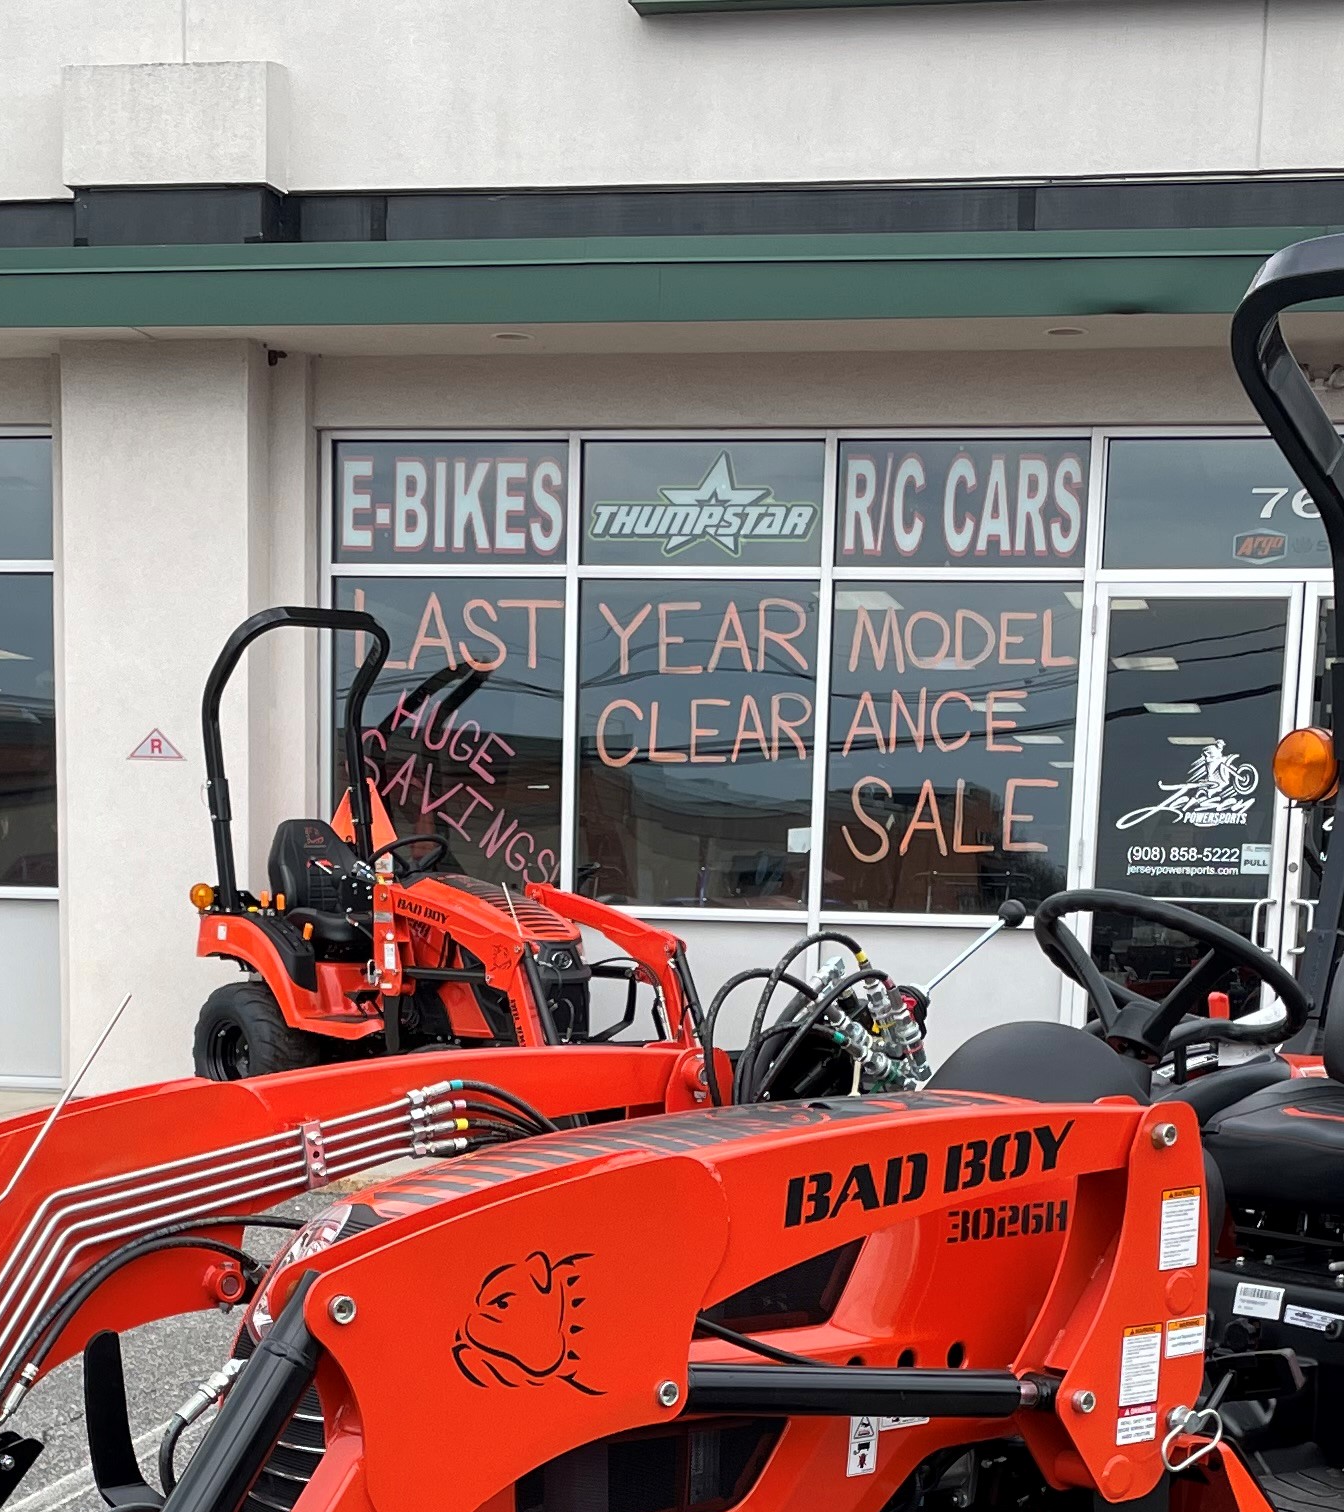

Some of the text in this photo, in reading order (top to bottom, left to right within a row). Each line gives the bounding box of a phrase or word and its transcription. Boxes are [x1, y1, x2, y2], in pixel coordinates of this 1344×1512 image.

[342, 456, 563, 555] E-BIKES
[592, 502, 814, 541] THUMPSTAR
[843, 453, 1084, 557] R/C CARS
[1237, 536, 1283, 556] Argo
[354, 588, 1078, 675] LAST YEAR MODEL
[150, 738, 162, 754] R
[391, 688, 517, 784] HUGE
[841, 775, 1058, 864] SALE
[1116, 780, 1256, 829] Jersey
[1183, 812, 1248, 826] POWERSPORTS
[1126, 864, 1239, 876] jerseypowersports.com
[1127, 846, 1240, 864] (908) 858-5222
[397, 898, 448, 924] BAD BOY
[784, 1119, 1075, 1228] BAD BOY
[946, 1200, 1068, 1243] 3026H
